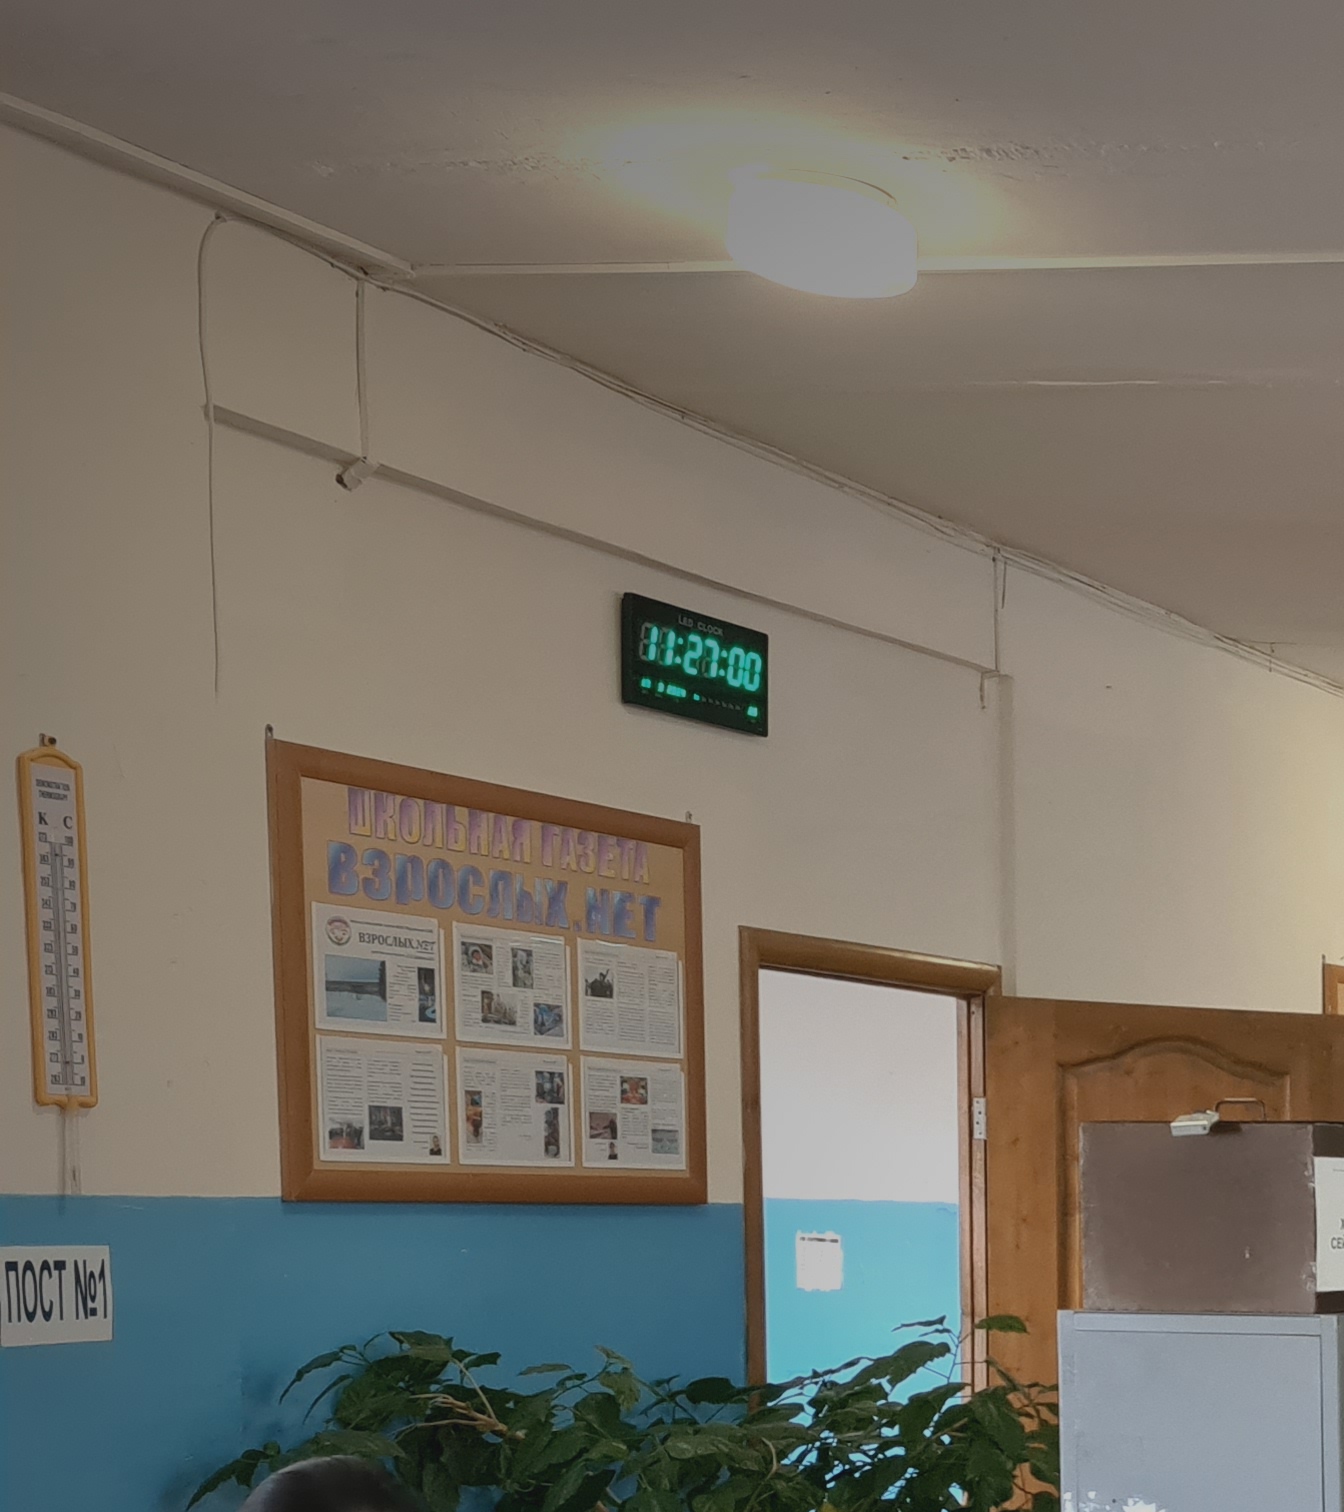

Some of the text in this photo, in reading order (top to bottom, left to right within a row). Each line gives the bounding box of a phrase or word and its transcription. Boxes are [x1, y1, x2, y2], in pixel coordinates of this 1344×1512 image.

[648, 626, 762, 692] 11:27:00
[347, 786, 650, 885] ШКОЛЬНАЯ ГАЗЕТА
[5, 1259, 66, 1323] ПОСТ
